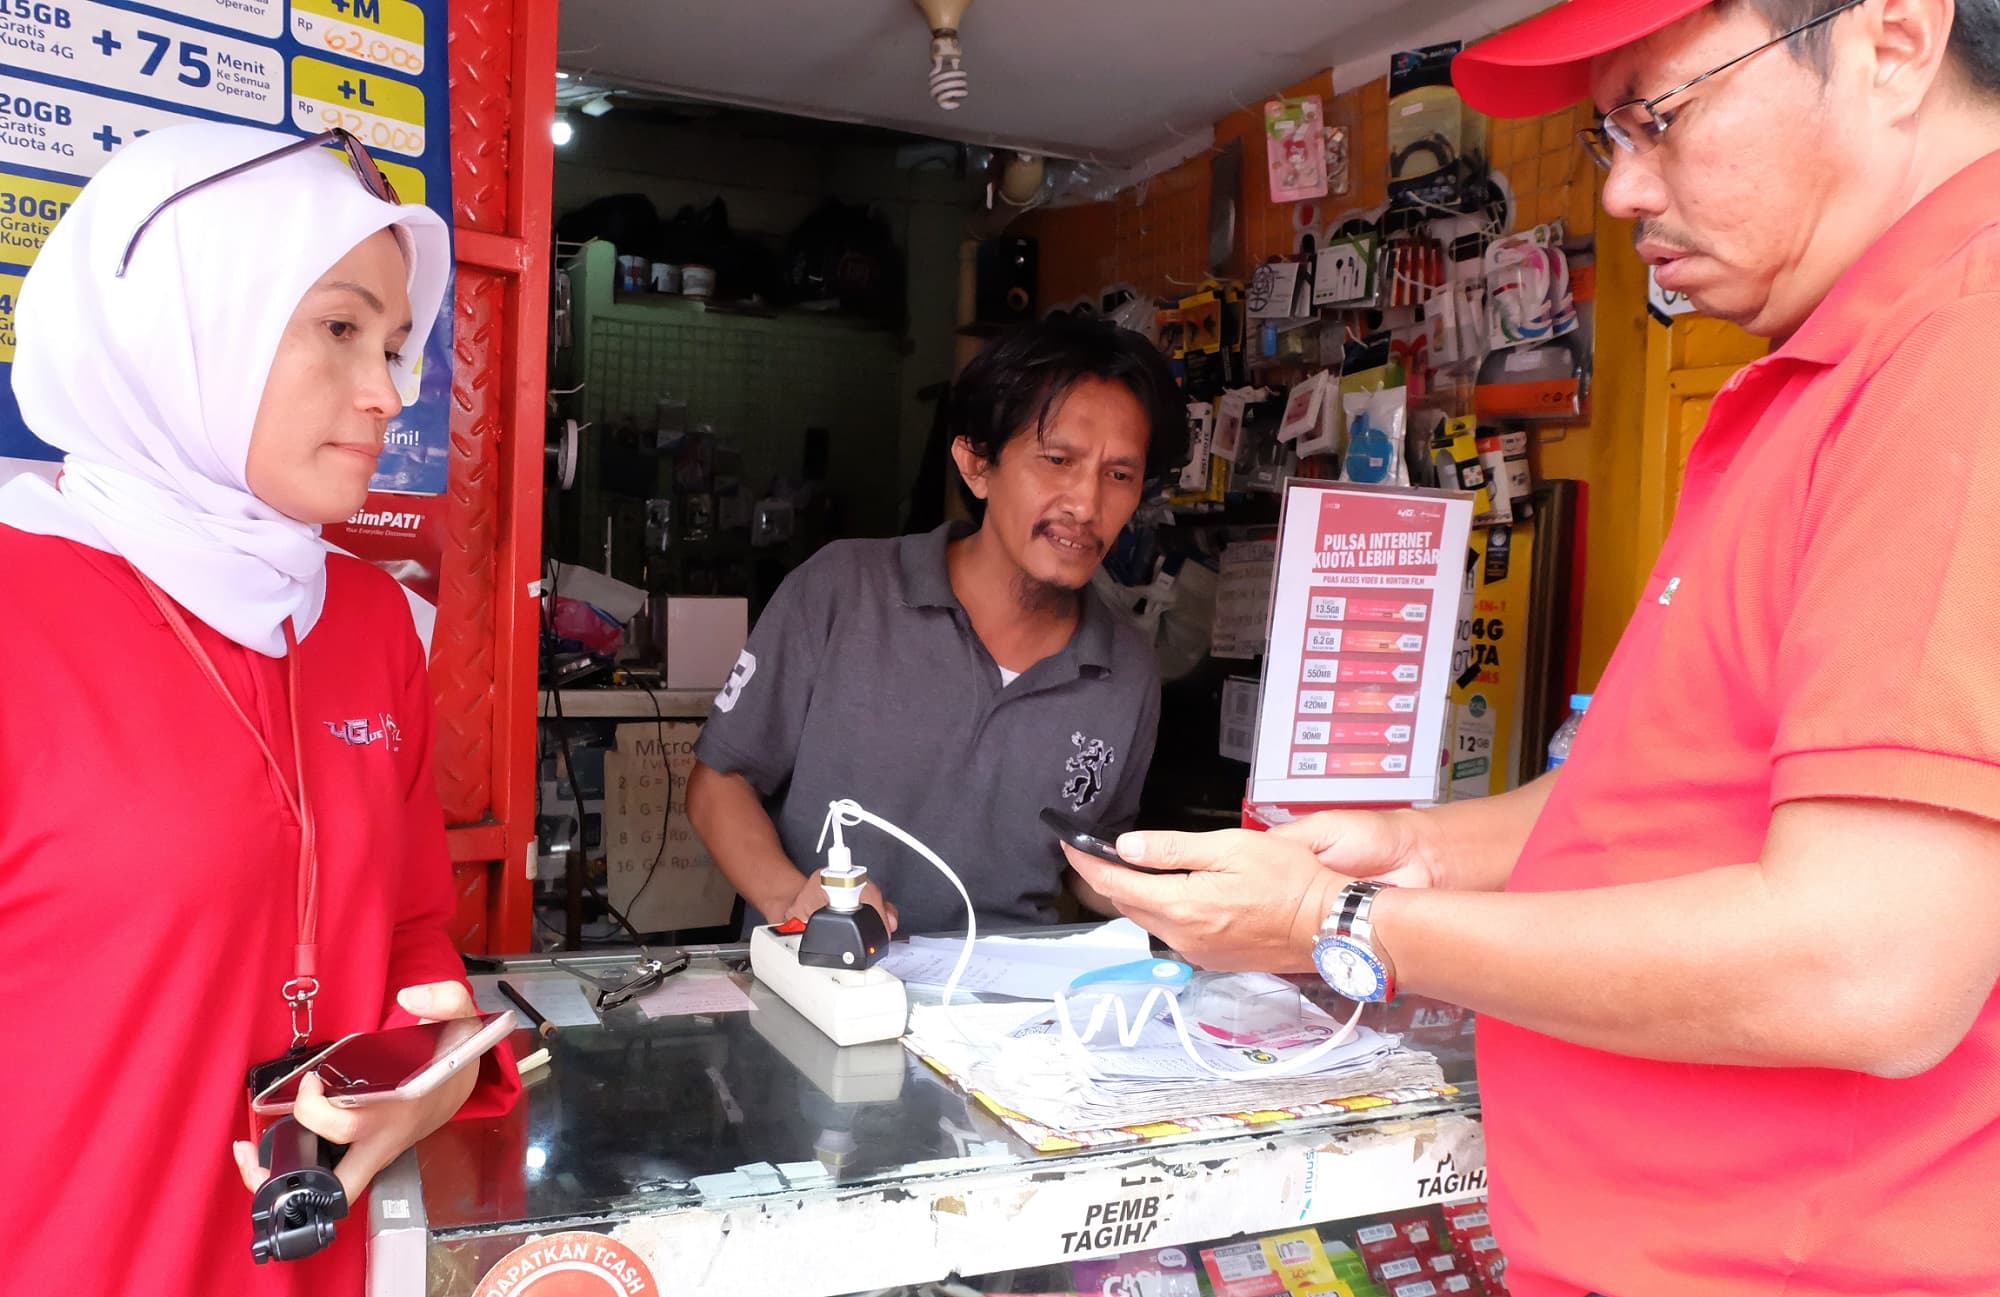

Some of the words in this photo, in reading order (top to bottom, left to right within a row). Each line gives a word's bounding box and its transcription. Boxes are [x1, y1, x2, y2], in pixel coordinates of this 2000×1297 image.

[0, 17, 45, 39] Gratis
[298, 18, 313, 31] Rp
[50, 44, 74, 59] 4G
[137, 31, 211, 88] 75
[217, 52, 265, 76] Menit
[217, 69, 231, 80] Ke
[233, 73, 271, 90] Semua
[217, 83, 267, 102] Operator
[0, 93, 72, 126] 20GB
[298, 101, 314, 114] Rp
[0, 116, 46, 137] Gratis
[51, 142, 74, 157] 4G
[0, 217, 49, 236] Gratis
[347, 509, 421, 530] simPATI
[1324, 533, 1366, 551] PULSA
[1369, 532, 1432, 549] INTERNET
[1313, 551, 1355, 568] KUOTA
[1359, 550, 1395, 567] LEBIH
[1398, 548, 1440, 565] BESAR
[1417, 1169, 1488, 1199] TAGIH
[1085, 1195, 1174, 1226] PEMB
[593, 1246, 645, 1295] TCASH
